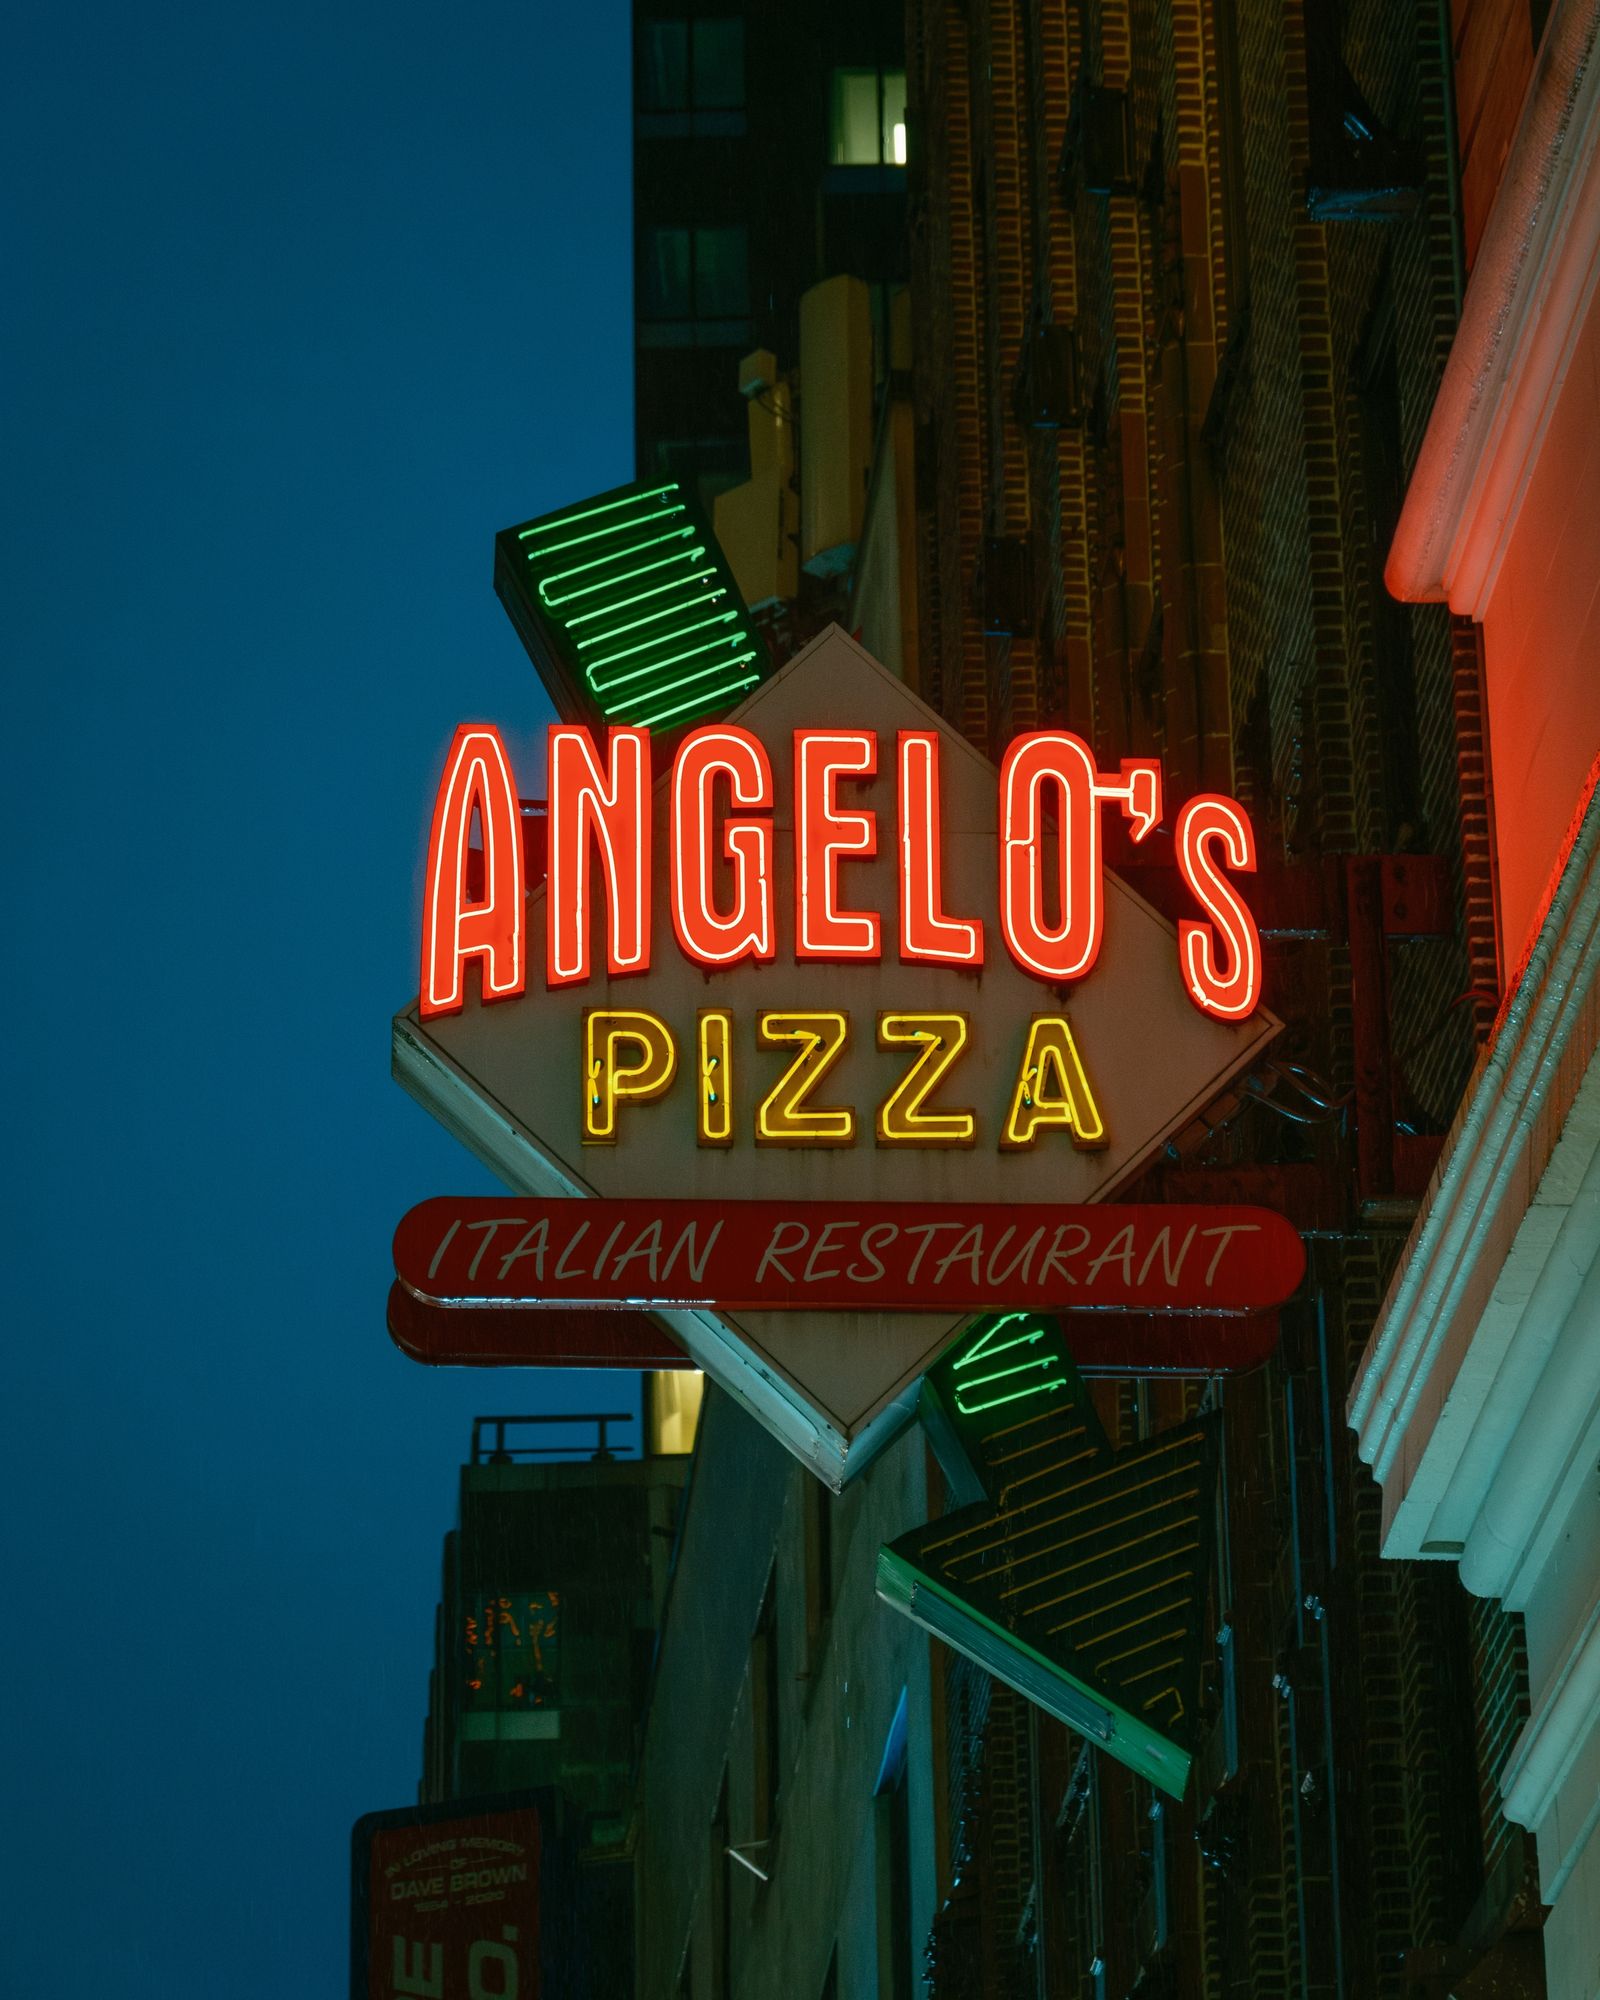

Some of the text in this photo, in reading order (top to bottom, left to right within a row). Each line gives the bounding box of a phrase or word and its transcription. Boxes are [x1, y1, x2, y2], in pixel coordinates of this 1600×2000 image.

[420, 723, 1264, 1021] ANGELO'S
[580, 1008, 1111, 1150] PIZZA
[427, 1219, 1261, 1288] ITALIAN RESTAURANT
[391, 1863, 528, 1900] DAVE BROWN
[403, 1839, 457, 1867] LOVING
